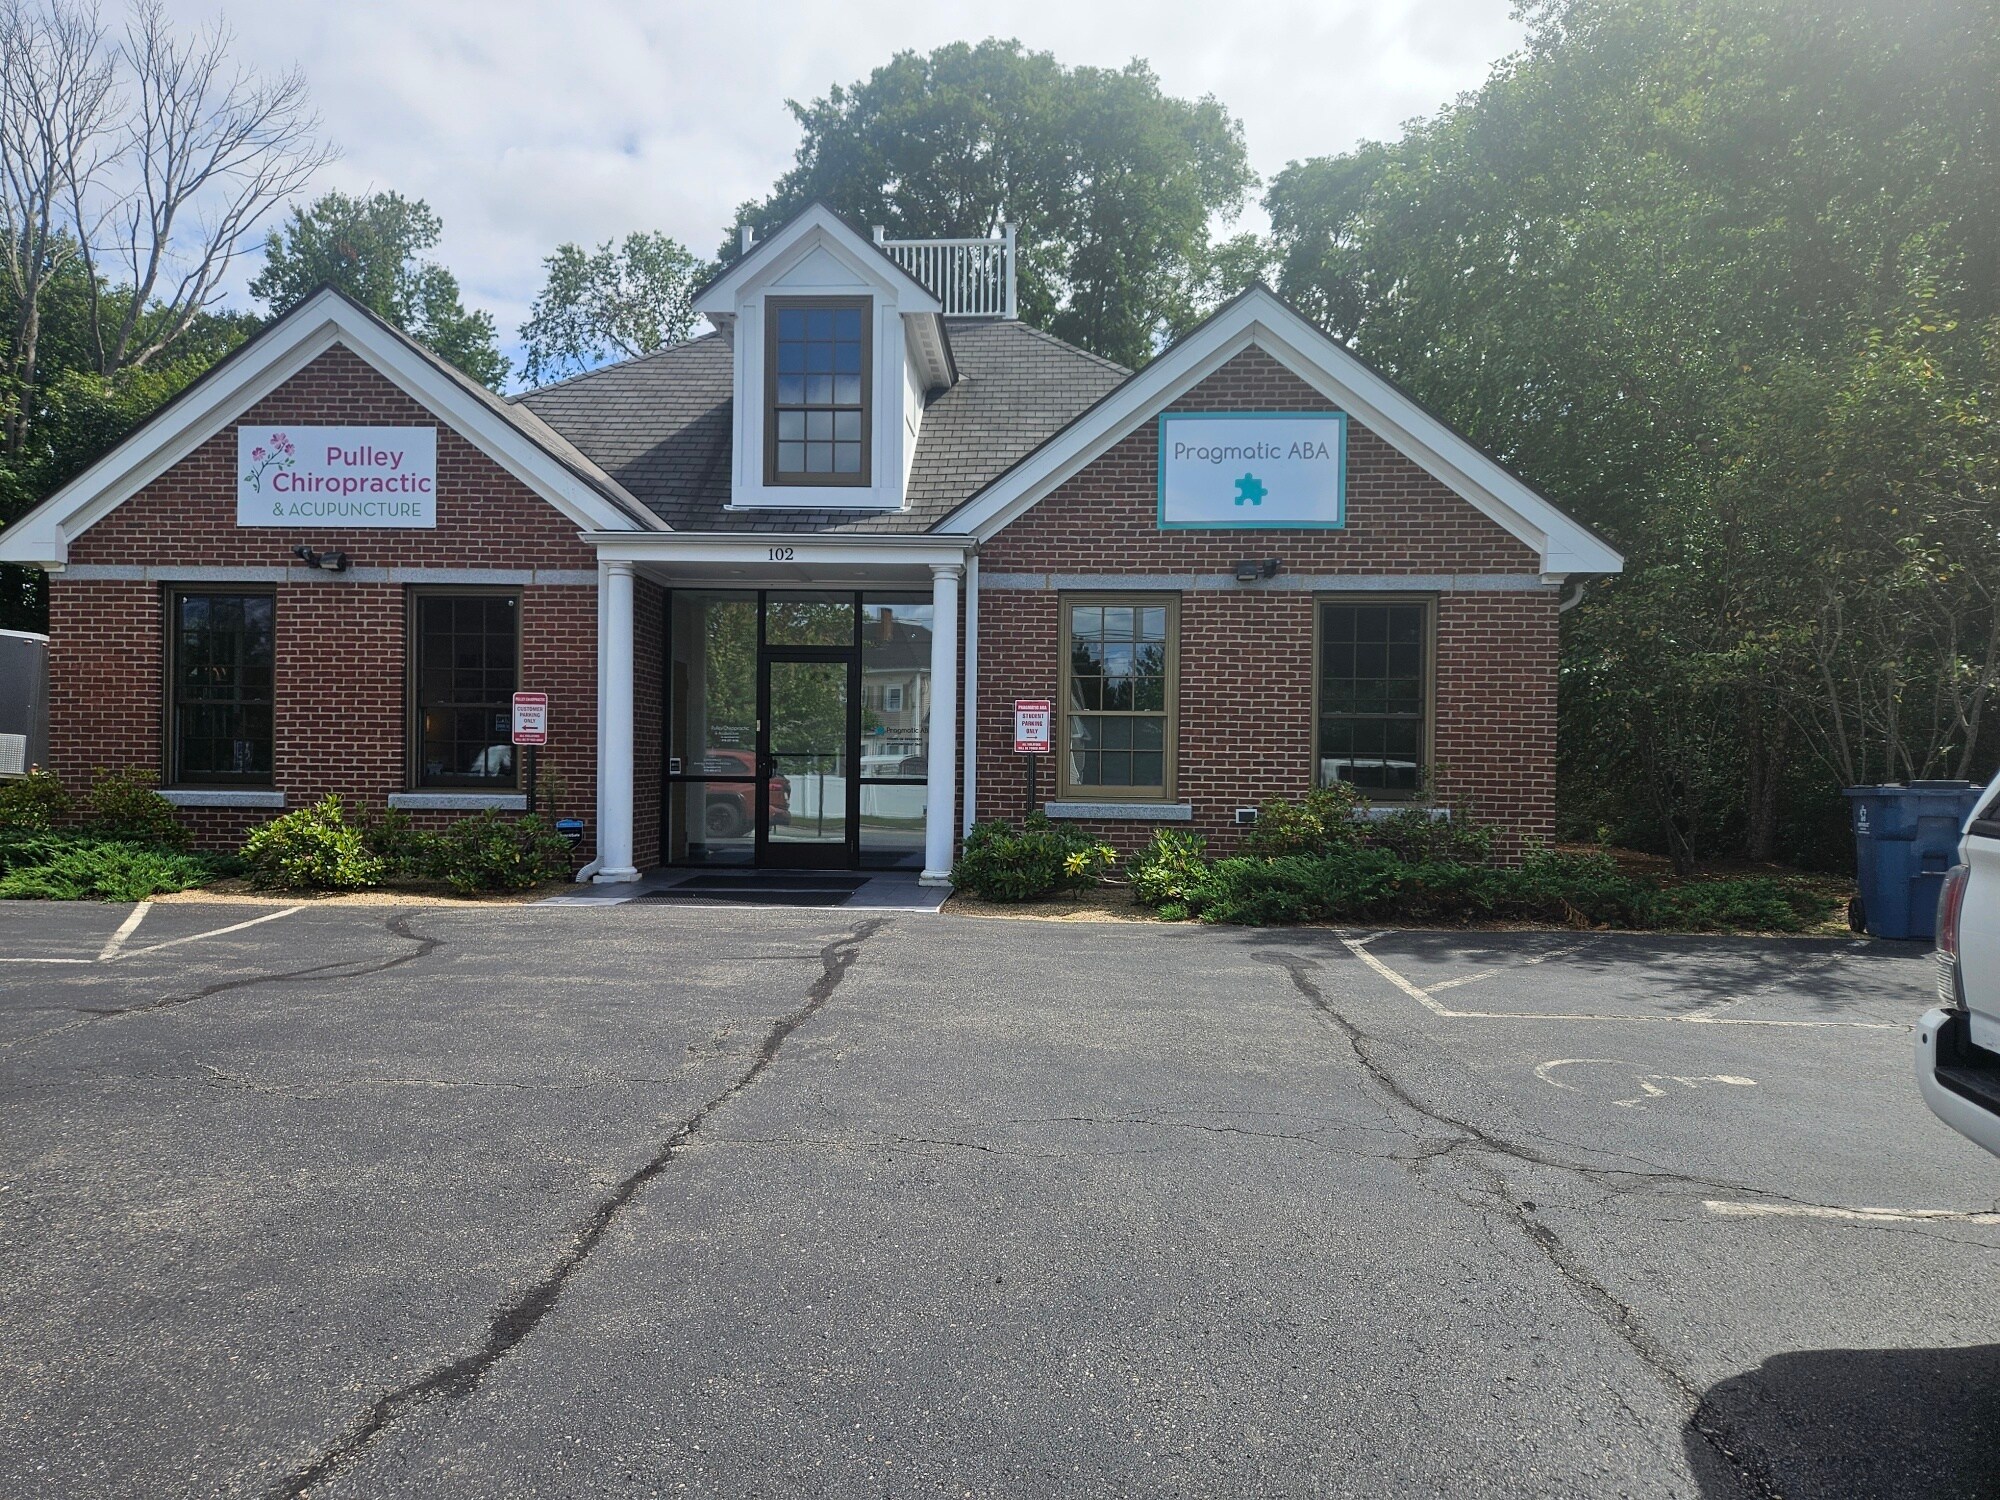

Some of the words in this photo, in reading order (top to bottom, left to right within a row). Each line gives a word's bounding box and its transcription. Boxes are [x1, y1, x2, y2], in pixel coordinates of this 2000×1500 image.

[326, 446, 404, 470] Pulley
[1174, 441, 1281, 464] Pragmatic
[1287, 441, 1330, 460] ABA
[272, 472, 431, 496] Chiropractic
[272, 502, 284, 517] &
[288, 502, 421, 517] ACUPUNCTURE
[768, 547, 794, 561] 102
[886, 726, 919, 735] Pragmatic
